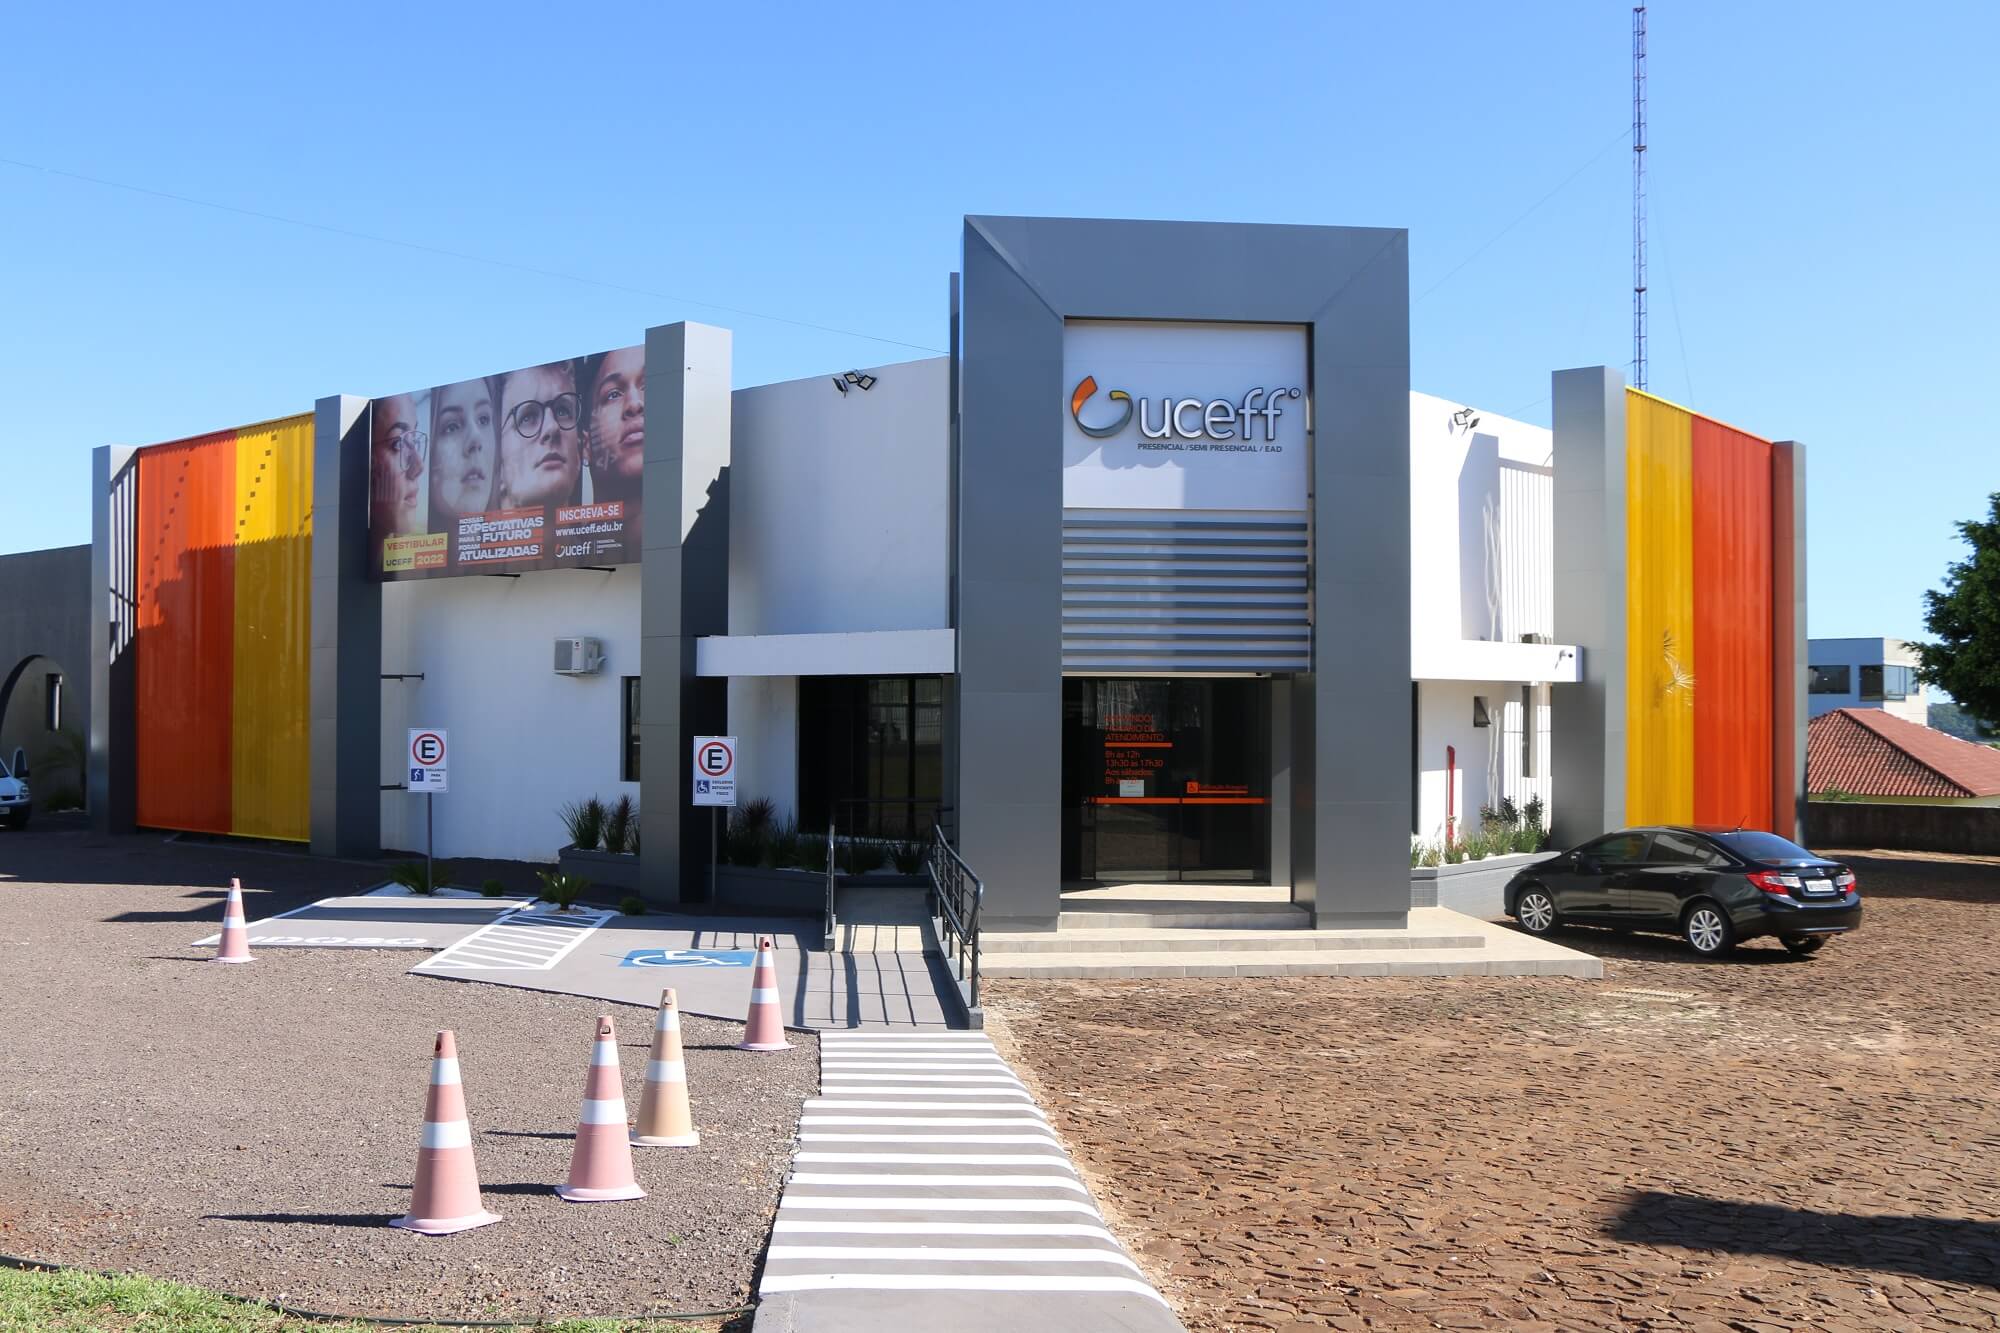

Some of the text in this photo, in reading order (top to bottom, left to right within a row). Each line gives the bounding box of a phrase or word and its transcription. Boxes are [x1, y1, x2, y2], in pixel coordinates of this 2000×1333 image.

[1140, 387, 1286, 440] uceff
[1137, 443, 1184, 451] PRESENCIAL
[559, 505, 619, 521] INSCREVA-SE
[459, 516, 544, 535] EXPECTATIVAS
[555, 521, 623, 537] www.uceff.edu.br
[482, 528, 532, 543] FUTURO
[386, 538, 444, 551] VESTIBULAR
[565, 541, 592, 556] uceff
[386, 554, 445, 566] UCEFF 2022
[421, 739, 436, 759] E
[707, 748, 723, 769] E
